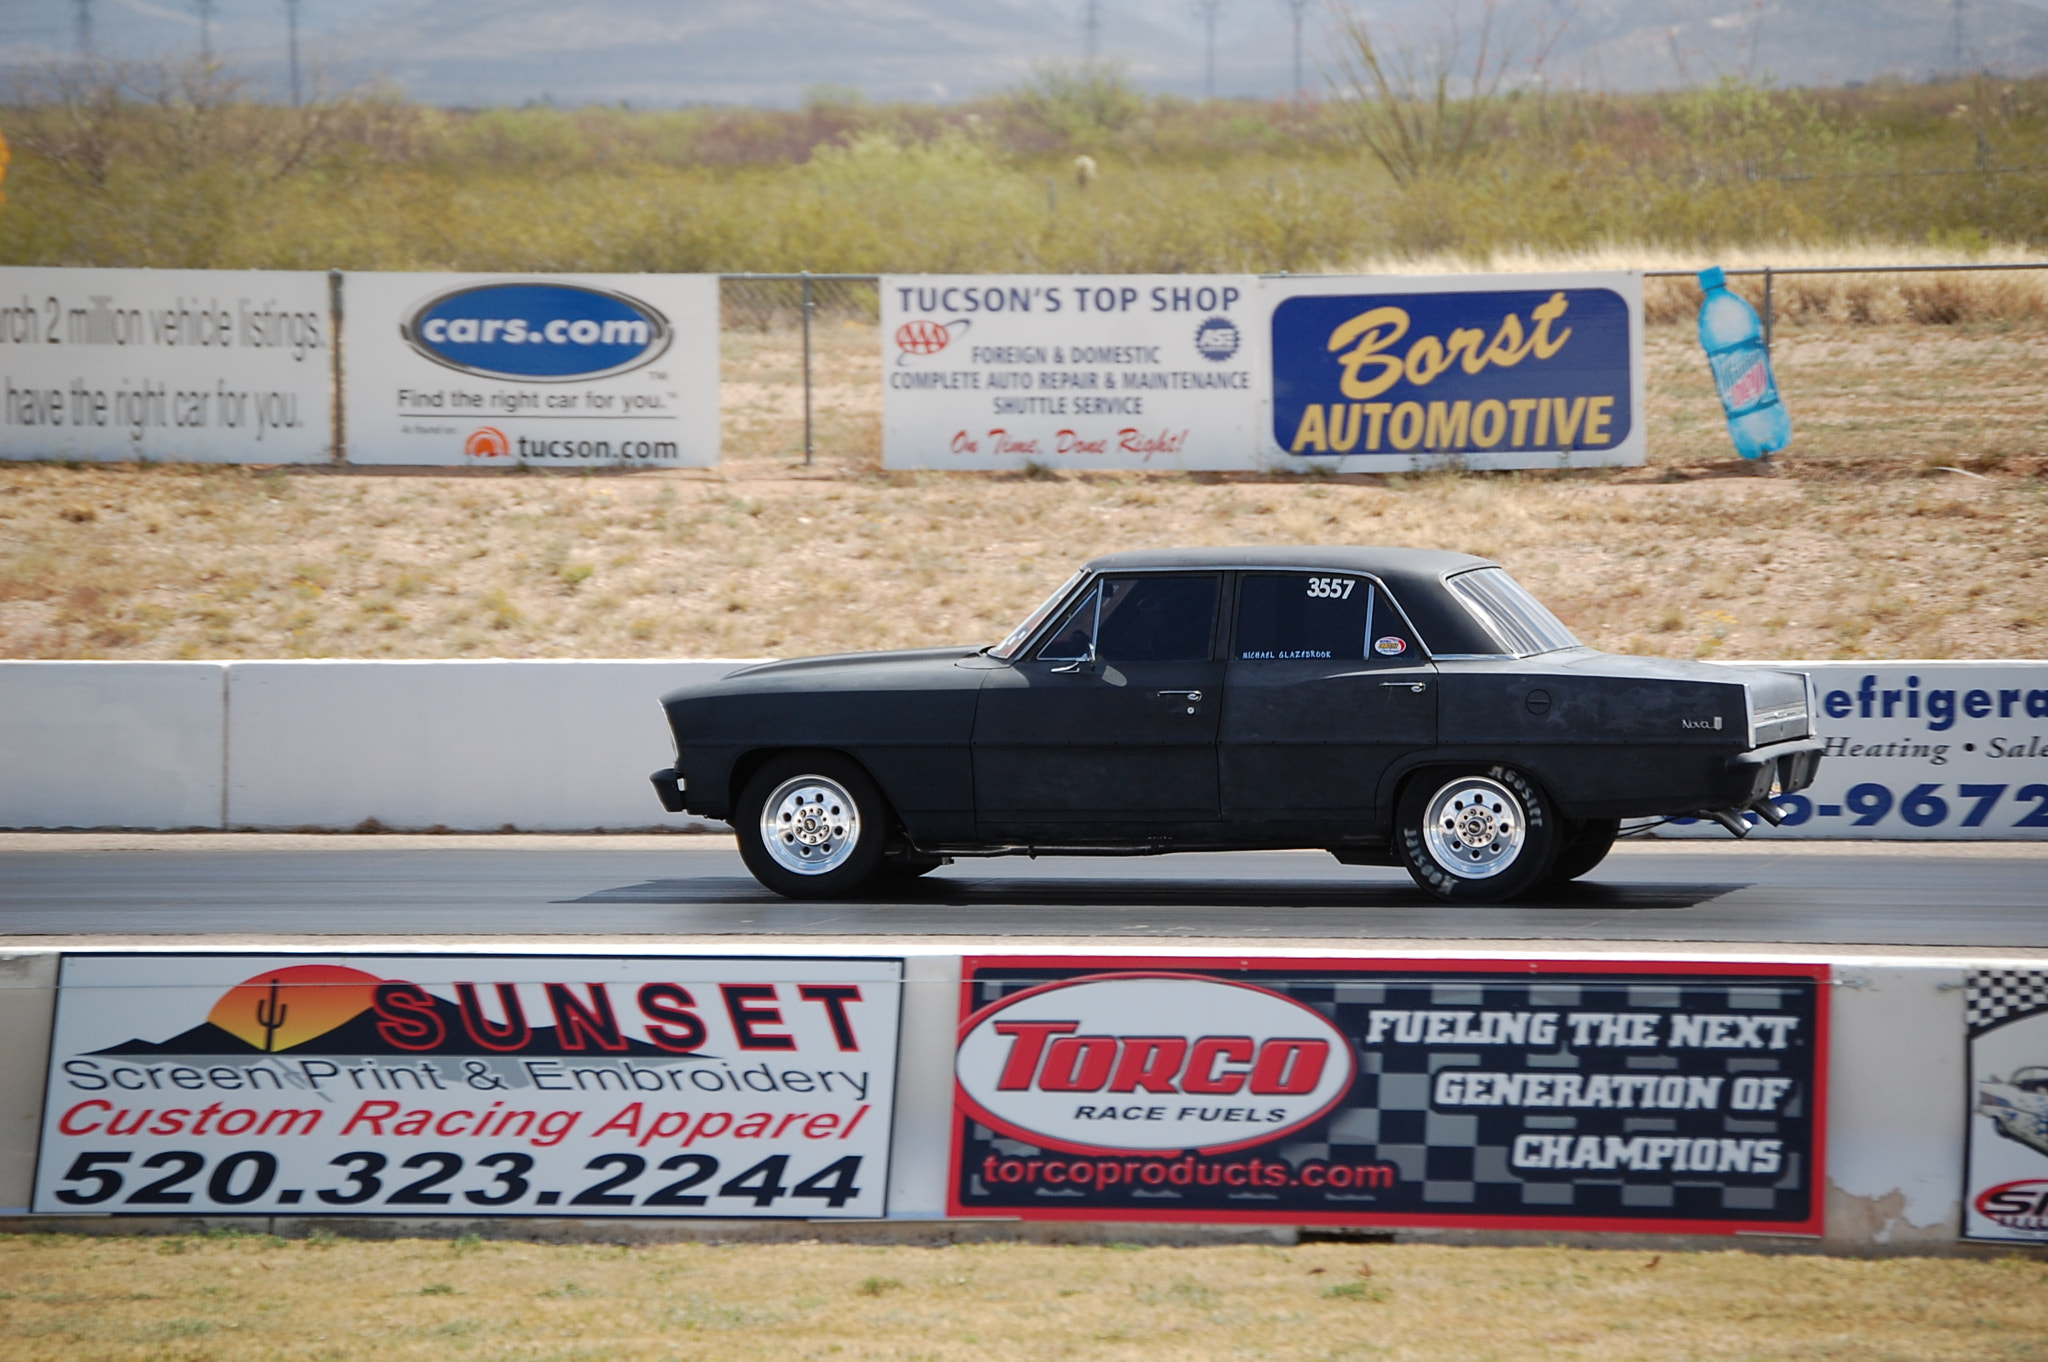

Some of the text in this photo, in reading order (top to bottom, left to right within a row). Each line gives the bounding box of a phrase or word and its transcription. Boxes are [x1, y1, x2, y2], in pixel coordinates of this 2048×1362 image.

[897, 287, 1240, 312] TUCSON'S TOP SHOP
[46, 296, 60, 344] 2
[67, 296, 144, 344] million
[149, 297, 233, 346] vehicle
[423, 319, 648, 344] cars.com
[972, 347, 1161, 363] FOREIGN & DOMESTIC
[1327, 292, 1572, 399] Borst
[890, 372, 1250, 389] COMPLETE AUTO REPAIR & MAINTENANCE
[5, 376, 63, 426] have
[70, 377, 106, 426] the
[115, 378, 166, 441] right
[173, 391, 208, 427] car
[217, 378, 247, 427] for
[398, 389, 444, 408] Find
[450, 389, 482, 408] the
[490, 390, 540, 413] right
[546, 394, 578, 409] car
[585, 391, 614, 409] for
[993, 397, 1143, 414] SHUTTLE SERVICE
[1291, 396, 1615, 451] AUTOMOTIVE
[518, 436, 678, 459] tucson.com
[951, 430, 977, 454] On
[1056, 429, 1107, 453] Done
[1118, 427, 1189, 462] Right!
[1306, 577, 1356, 600] 3557
[1242, 650, 1332, 659] MICHAEL GLAZEBROOK
[1814, 675, 2048, 731] efrigera
[1820, 736, 2048, 765] Heating Sale
[371, 979, 864, 1053] SUNSET
[1366, 1010, 1798, 1049] FUELING THE NEXT
[62, 1058, 869, 1101] Screen Print & Embroidery
[1434, 1071, 1793, 1111] GENERATION OF
[58, 1099, 872, 1148] Custom Racing Apparel
[1073, 1106, 1287, 1123] RACE FUELS
[1512, 1135, 1784, 1174] CHAMPIONS
[54, 1150, 864, 1208] 520.323.2244
[982, 1155, 1396, 1190] torcoproducts.com
